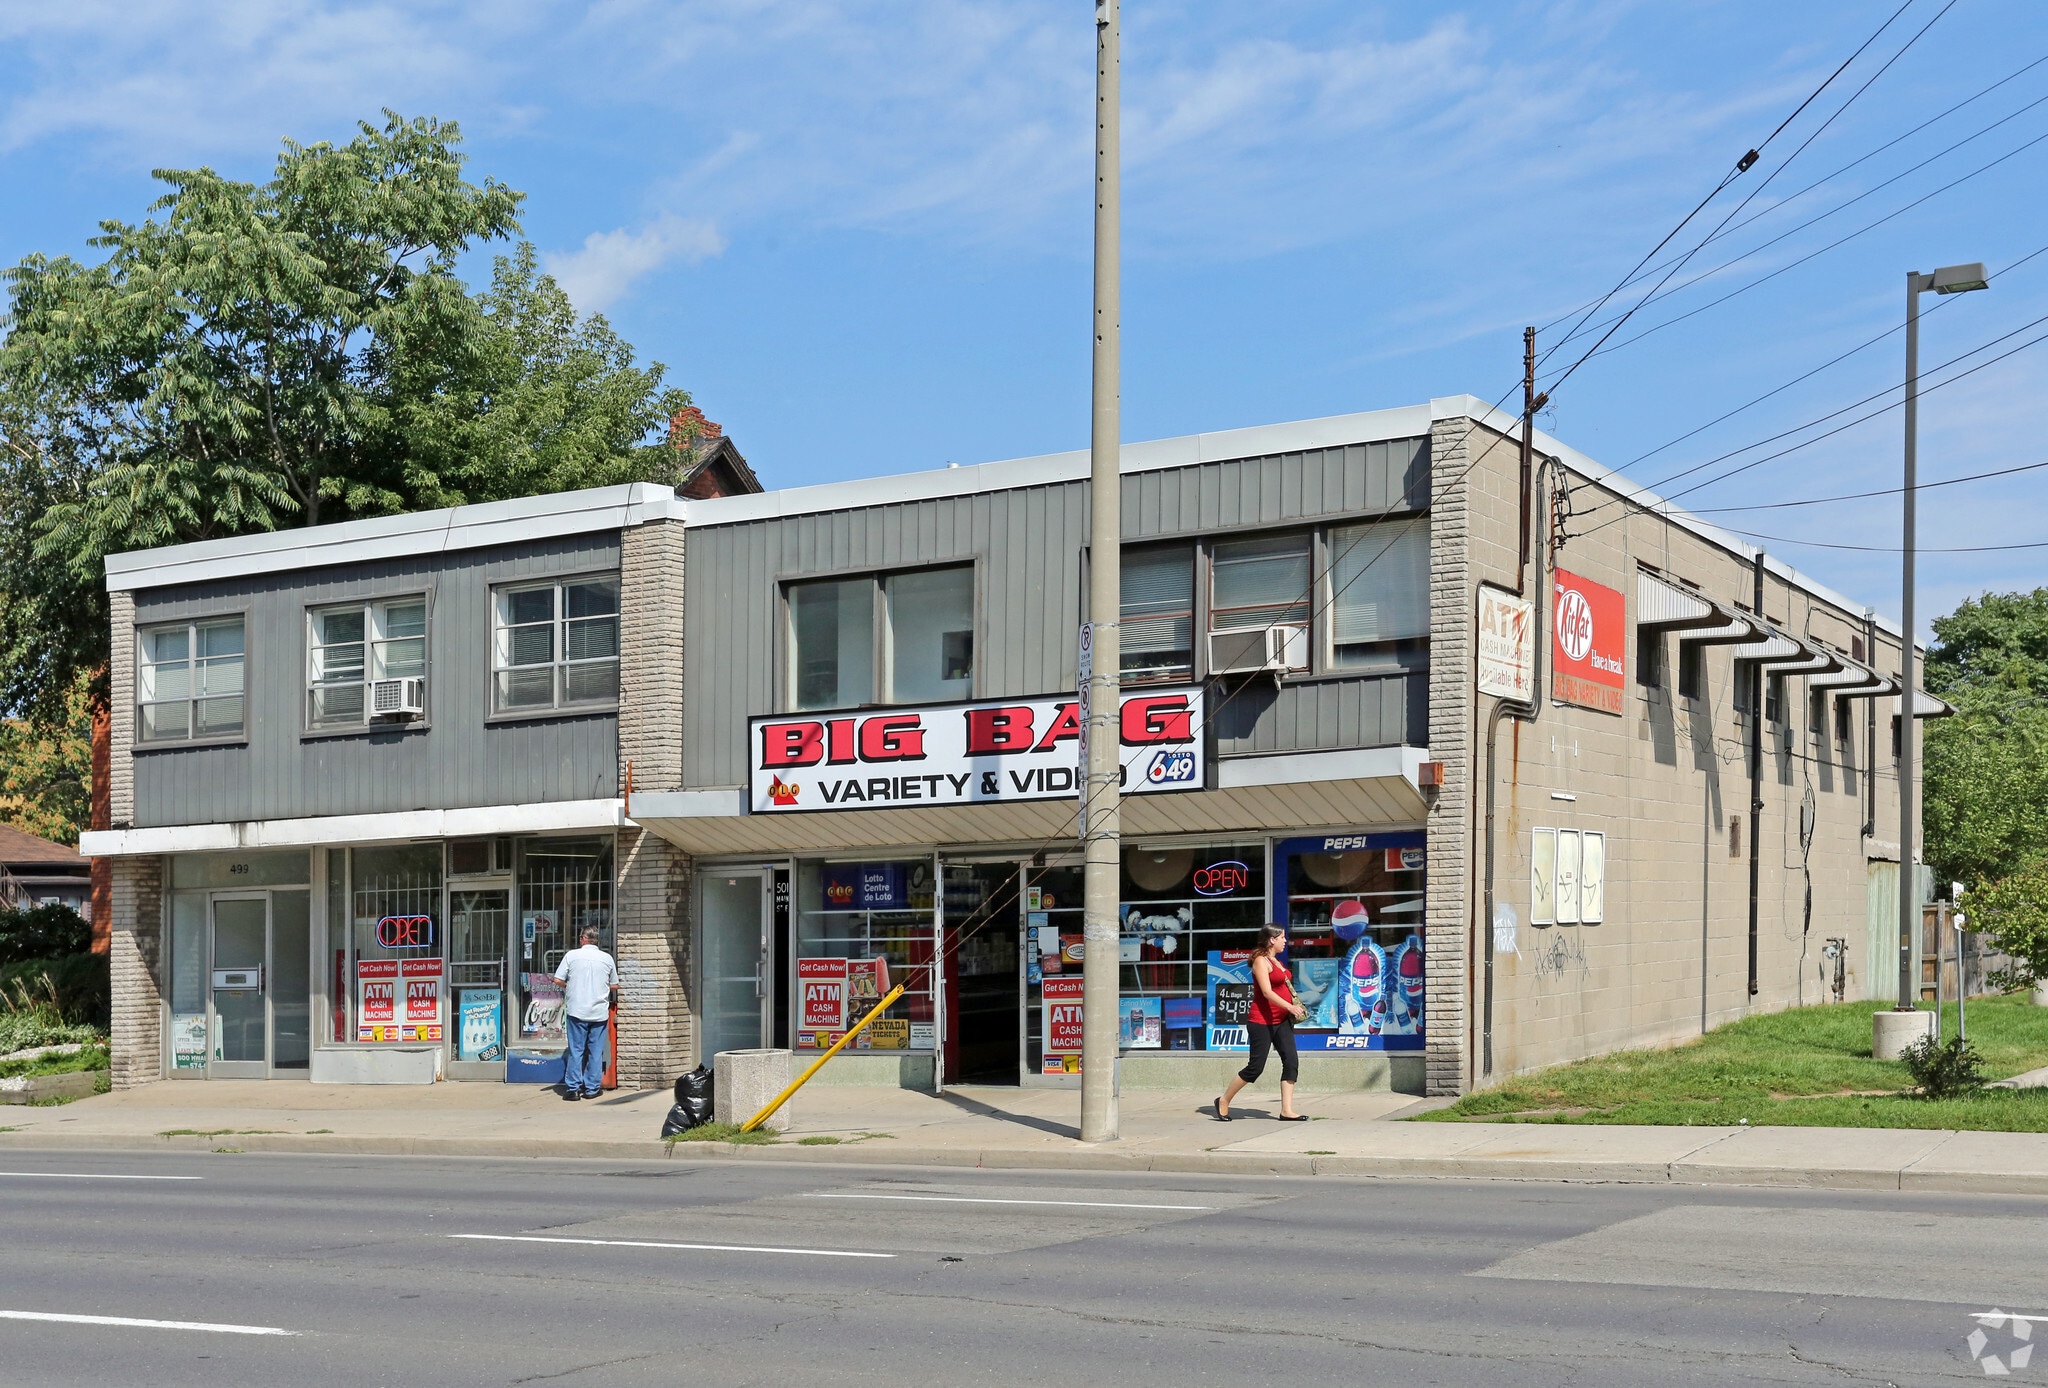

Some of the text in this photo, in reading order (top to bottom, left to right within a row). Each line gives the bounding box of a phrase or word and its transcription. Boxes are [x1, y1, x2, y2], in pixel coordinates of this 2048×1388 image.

[1481, 599, 1530, 645] ATM
[1561, 595, 1589, 655] KitKat
[1480, 638, 1498, 655] CASH
[1591, 649, 1604, 670] Have
[1480, 665, 1529, 691] Available Here
[759, 694, 1195, 770] BIG BAG
[768, 784, 798, 796] OLG
[818, 767, 1127, 804] VARIETY & VID
[1324, 836, 1366, 850] PEPSI
[230, 864, 248, 874] 499
[864, 874, 884, 882] Lotto
[1194, 868, 1246, 888] OPEN
[776, 882, 789, 894] 501
[828, 886, 852, 896] OLG
[864, 884, 890, 892] Centre
[875, 892, 892, 901] Loto
[383, 964, 397, 972] Now!
[1352, 976, 1380, 987] PEPS
[365, 984, 393, 999] ATM
[408, 983, 436, 998] ATM
[536, 984, 551, 992] Home
[807, 986, 840, 1000] ATM
[1059, 984, 1076, 992] Cash
[408, 1010, 436, 1018] MACHINE
[806, 1015, 839, 1024] MACHINE
[1052, 1006, 1083, 1023] ATM
[872, 1022, 906, 1030] NEVADA
[1059, 1026, 1082, 1034] CASH
[1212, 1029, 1250, 1046] MIL
[1326, 1036, 1368, 1048] PEPSI
